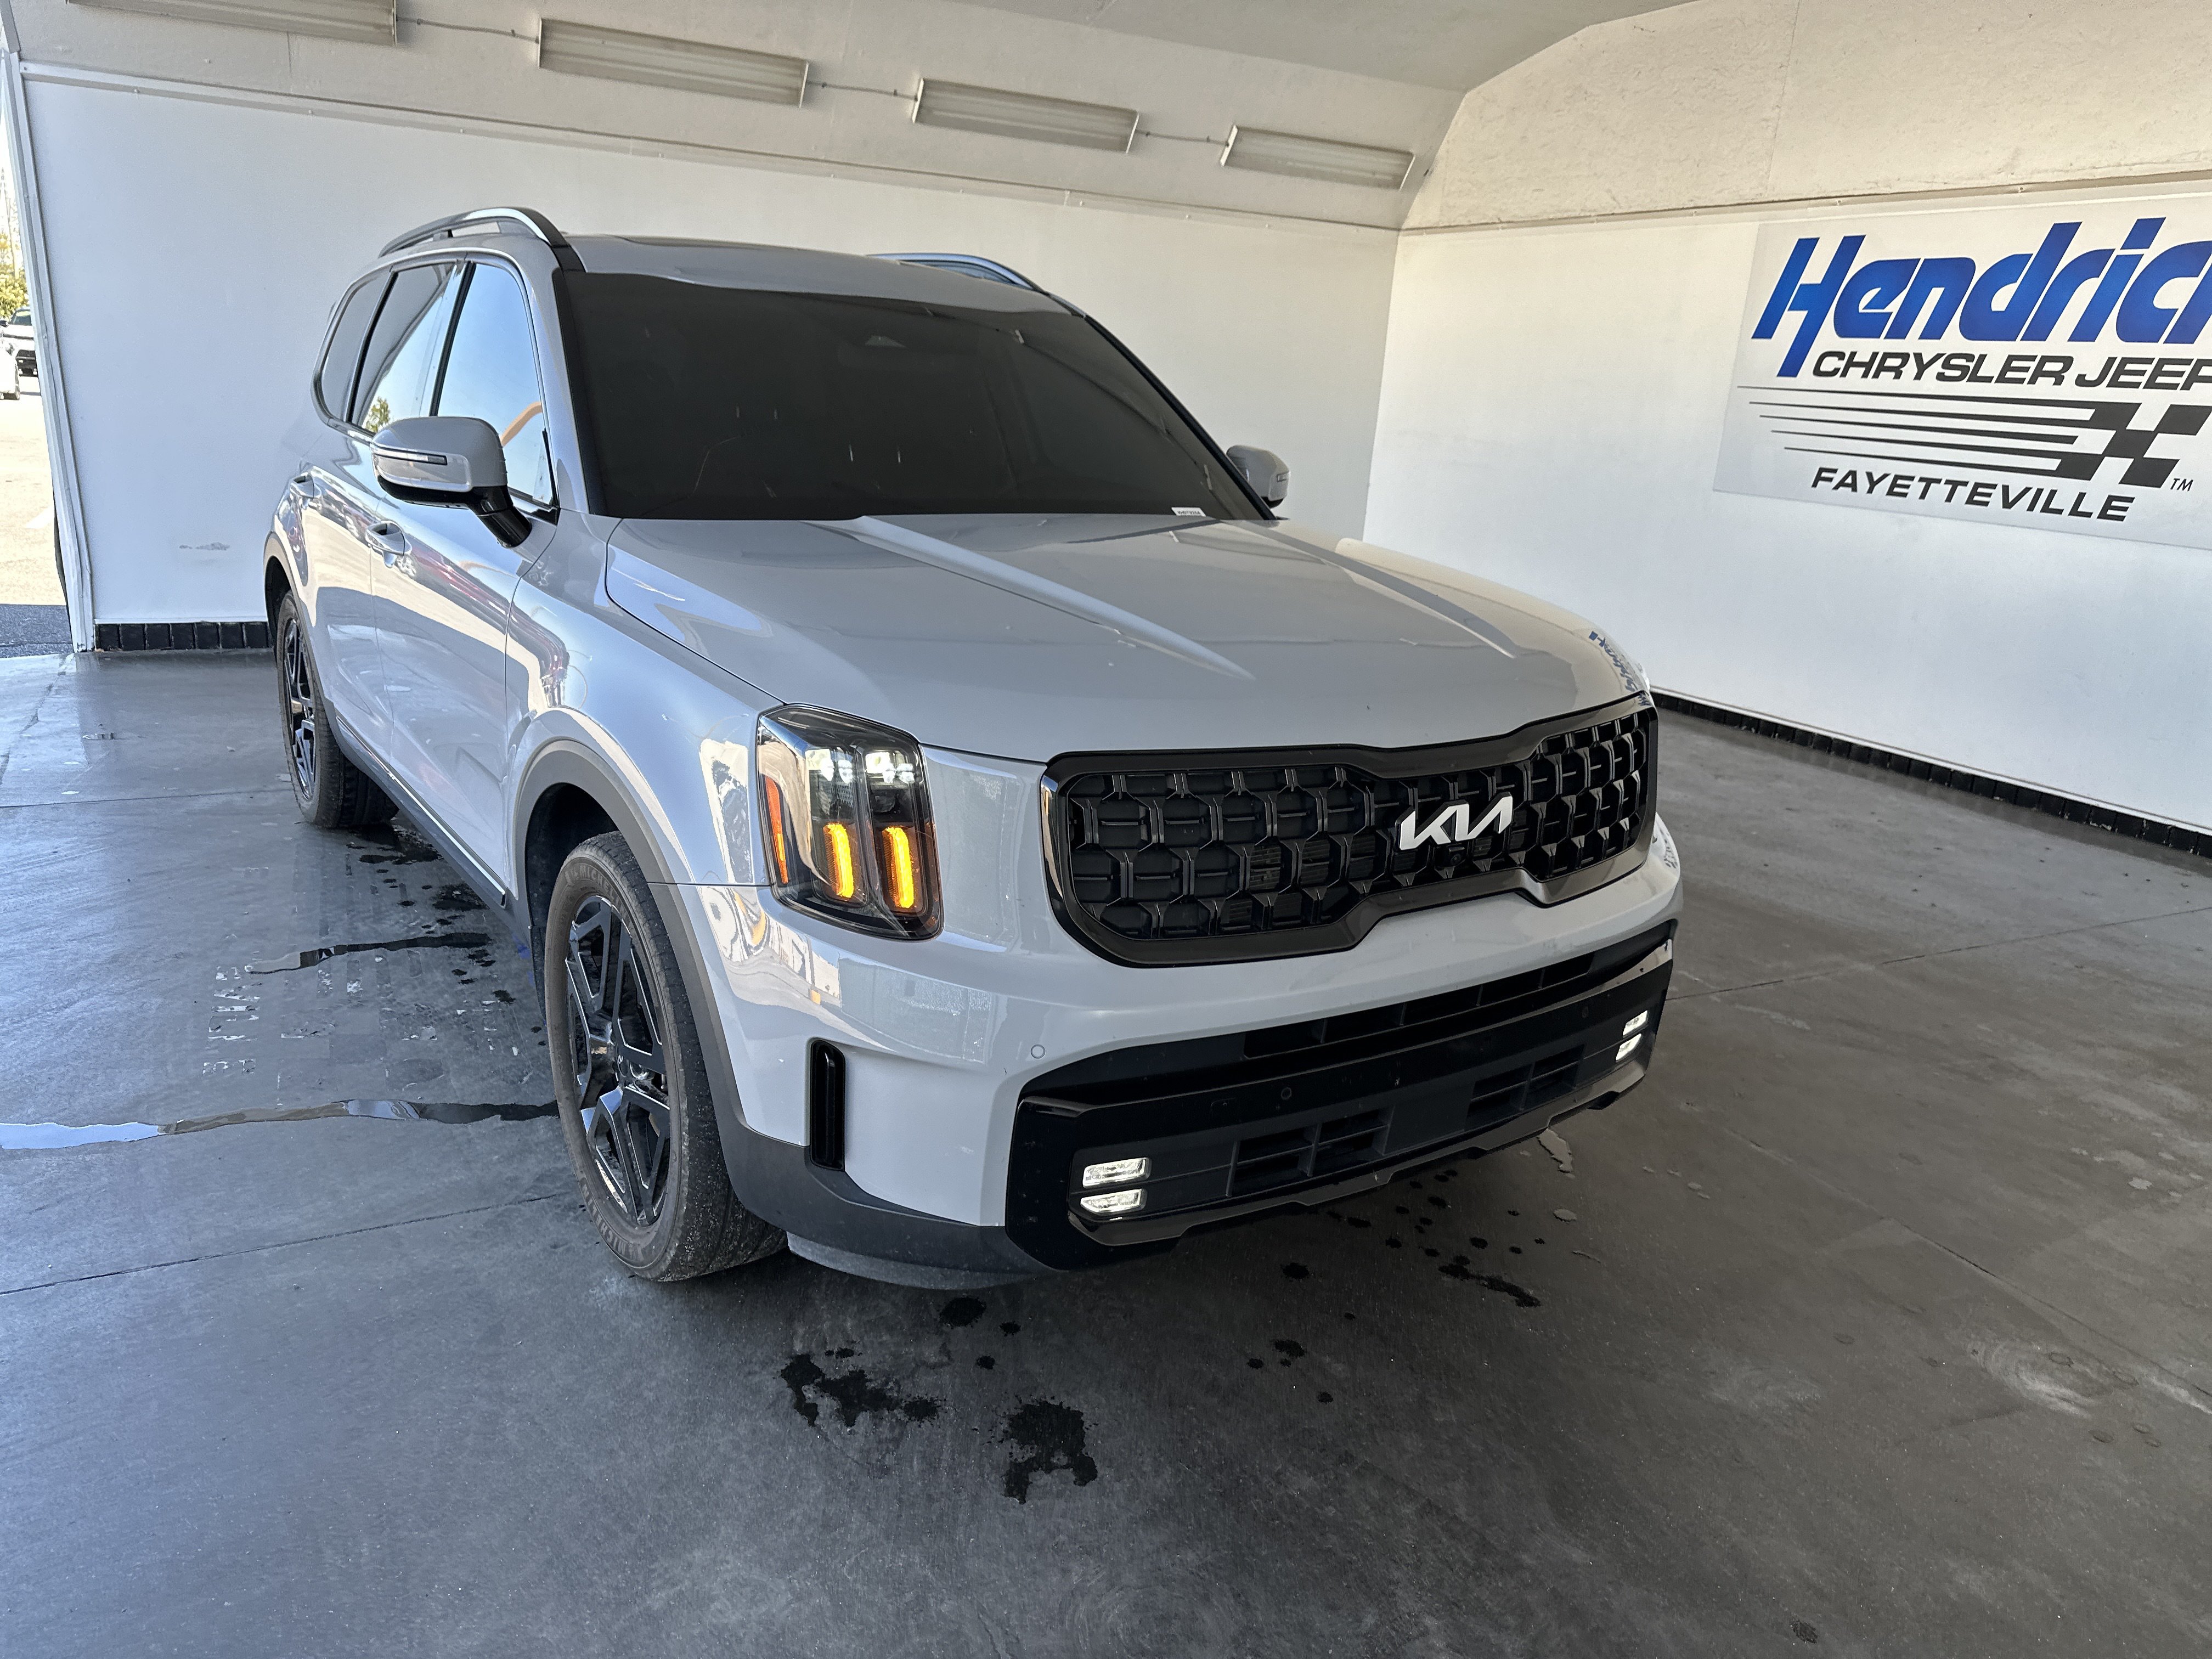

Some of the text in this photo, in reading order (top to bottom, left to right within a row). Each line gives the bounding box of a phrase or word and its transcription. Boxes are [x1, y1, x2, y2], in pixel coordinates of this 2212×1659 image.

[1812, 350, 2075, 386] CHRYSLER
[1811, 467, 2135, 522] FAYETTEVILLE
[2170, 478, 2194, 492] TM
[1398, 793, 1513, 850] KIA
